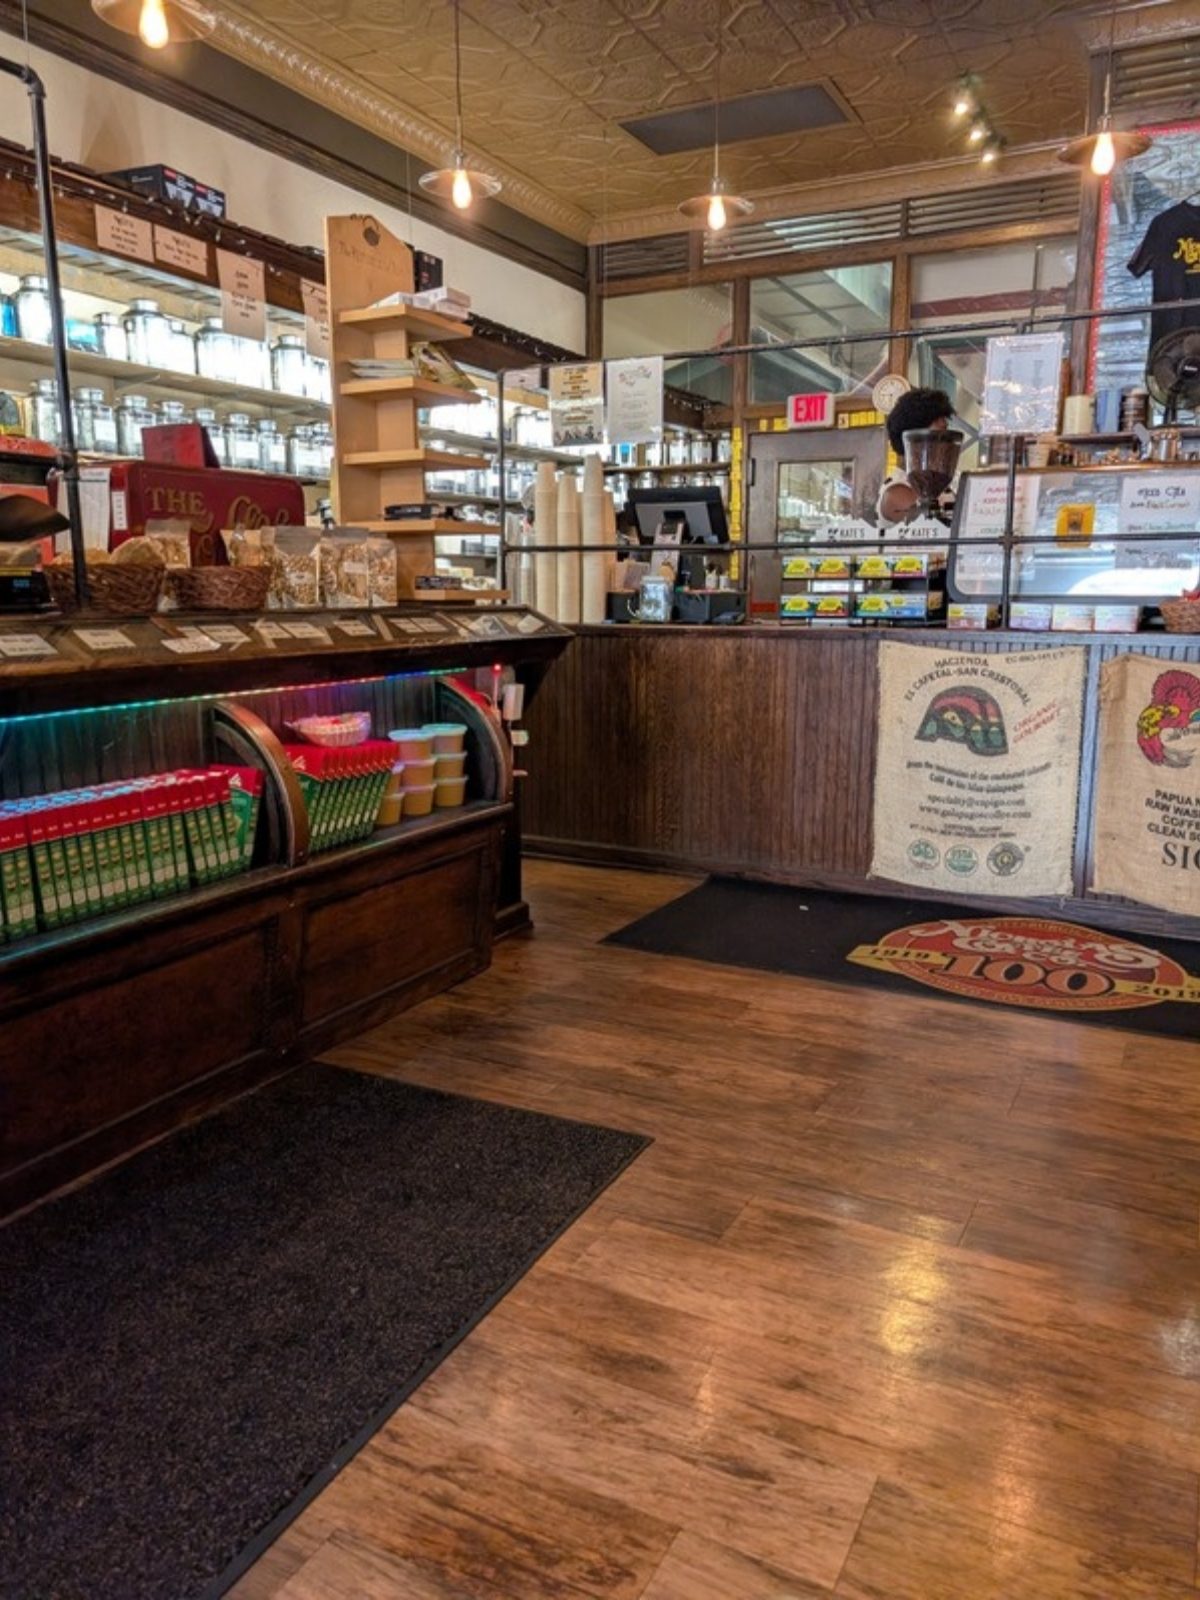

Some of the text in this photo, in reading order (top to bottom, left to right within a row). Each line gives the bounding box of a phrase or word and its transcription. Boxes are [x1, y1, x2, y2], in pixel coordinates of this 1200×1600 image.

[794, 394, 828, 423] EXIT
[145, 488, 207, 515] THE
[934, 656, 989, 668] HACIENDA
[1155, 789, 1192, 806] PAPUA
[1145, 798, 1200, 819] RAW WAS
[1147, 823, 1186, 840] CLEAN
[869, 948, 930, 960] 1919
[929, 952, 1116, 997] 100
[1133, 984, 1200, 1000] 2019
